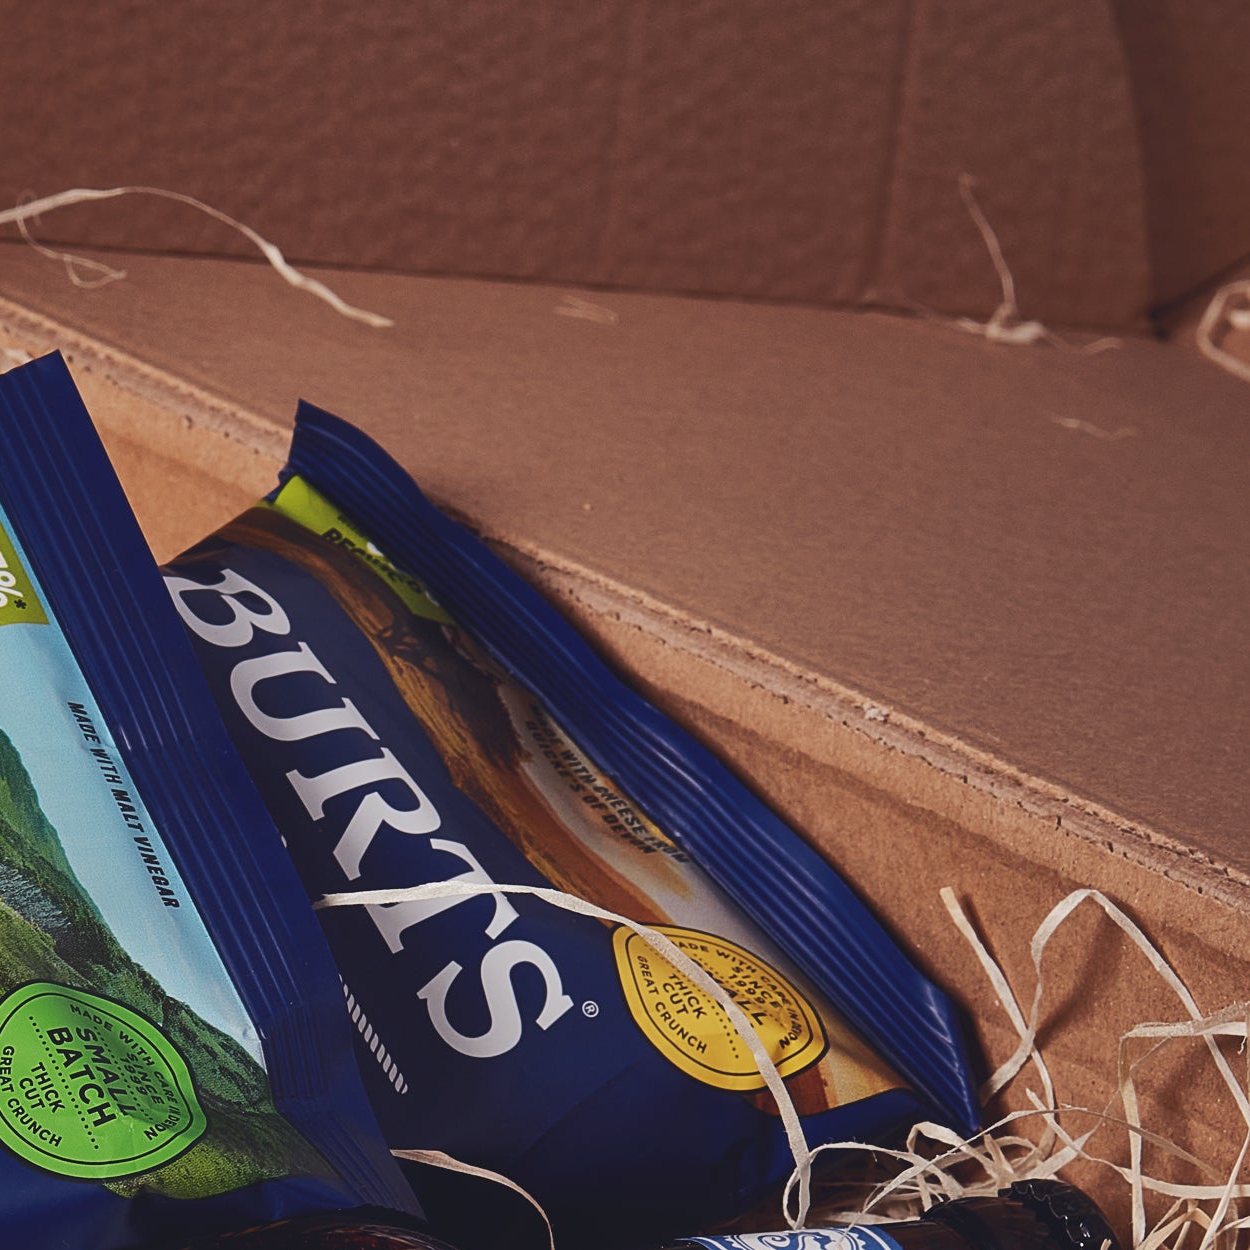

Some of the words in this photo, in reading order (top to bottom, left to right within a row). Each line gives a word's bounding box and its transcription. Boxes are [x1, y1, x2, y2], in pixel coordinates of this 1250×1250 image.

[67, 701, 102, 745] MADE
[90, 748, 123, 784] WITH
[111, 788, 145, 832] MALT
[134, 836, 181, 909] VINEGAR
[561, 750, 597, 784] WITH
[593, 785, 648, 835] CHEESE
[582, 794, 608, 810] OF
[671, 940, 709, 953] ADE
[716, 949, 757, 974] WITH
[637, 955, 660, 996] GREAT
[655, 1001, 708, 1054] CRUNCH
[662, 982, 689, 1015] CUT
[668, 973, 707, 1019] THICK
[731, 966, 783, 1009] SINCE
[0, 1046, 15, 1093] GREAT
[47, 1027, 117, 1127] BATCH
[69, 1003, 113, 1032] MADE
[119, 1030, 155, 1066] WITH
[154, 1071, 178, 1104] CARE
[168, 1105, 181, 1116] IN
[76, 1027, 137, 1117] SMALL
[120, 1057, 148, 1095] 1999
[126, 1053, 165, 1105] SINCE
[19, 1077, 46, 1110] CUT
[31, 1062, 65, 1113] THICK
[7, 1098, 62, 1147] CRUNCH
